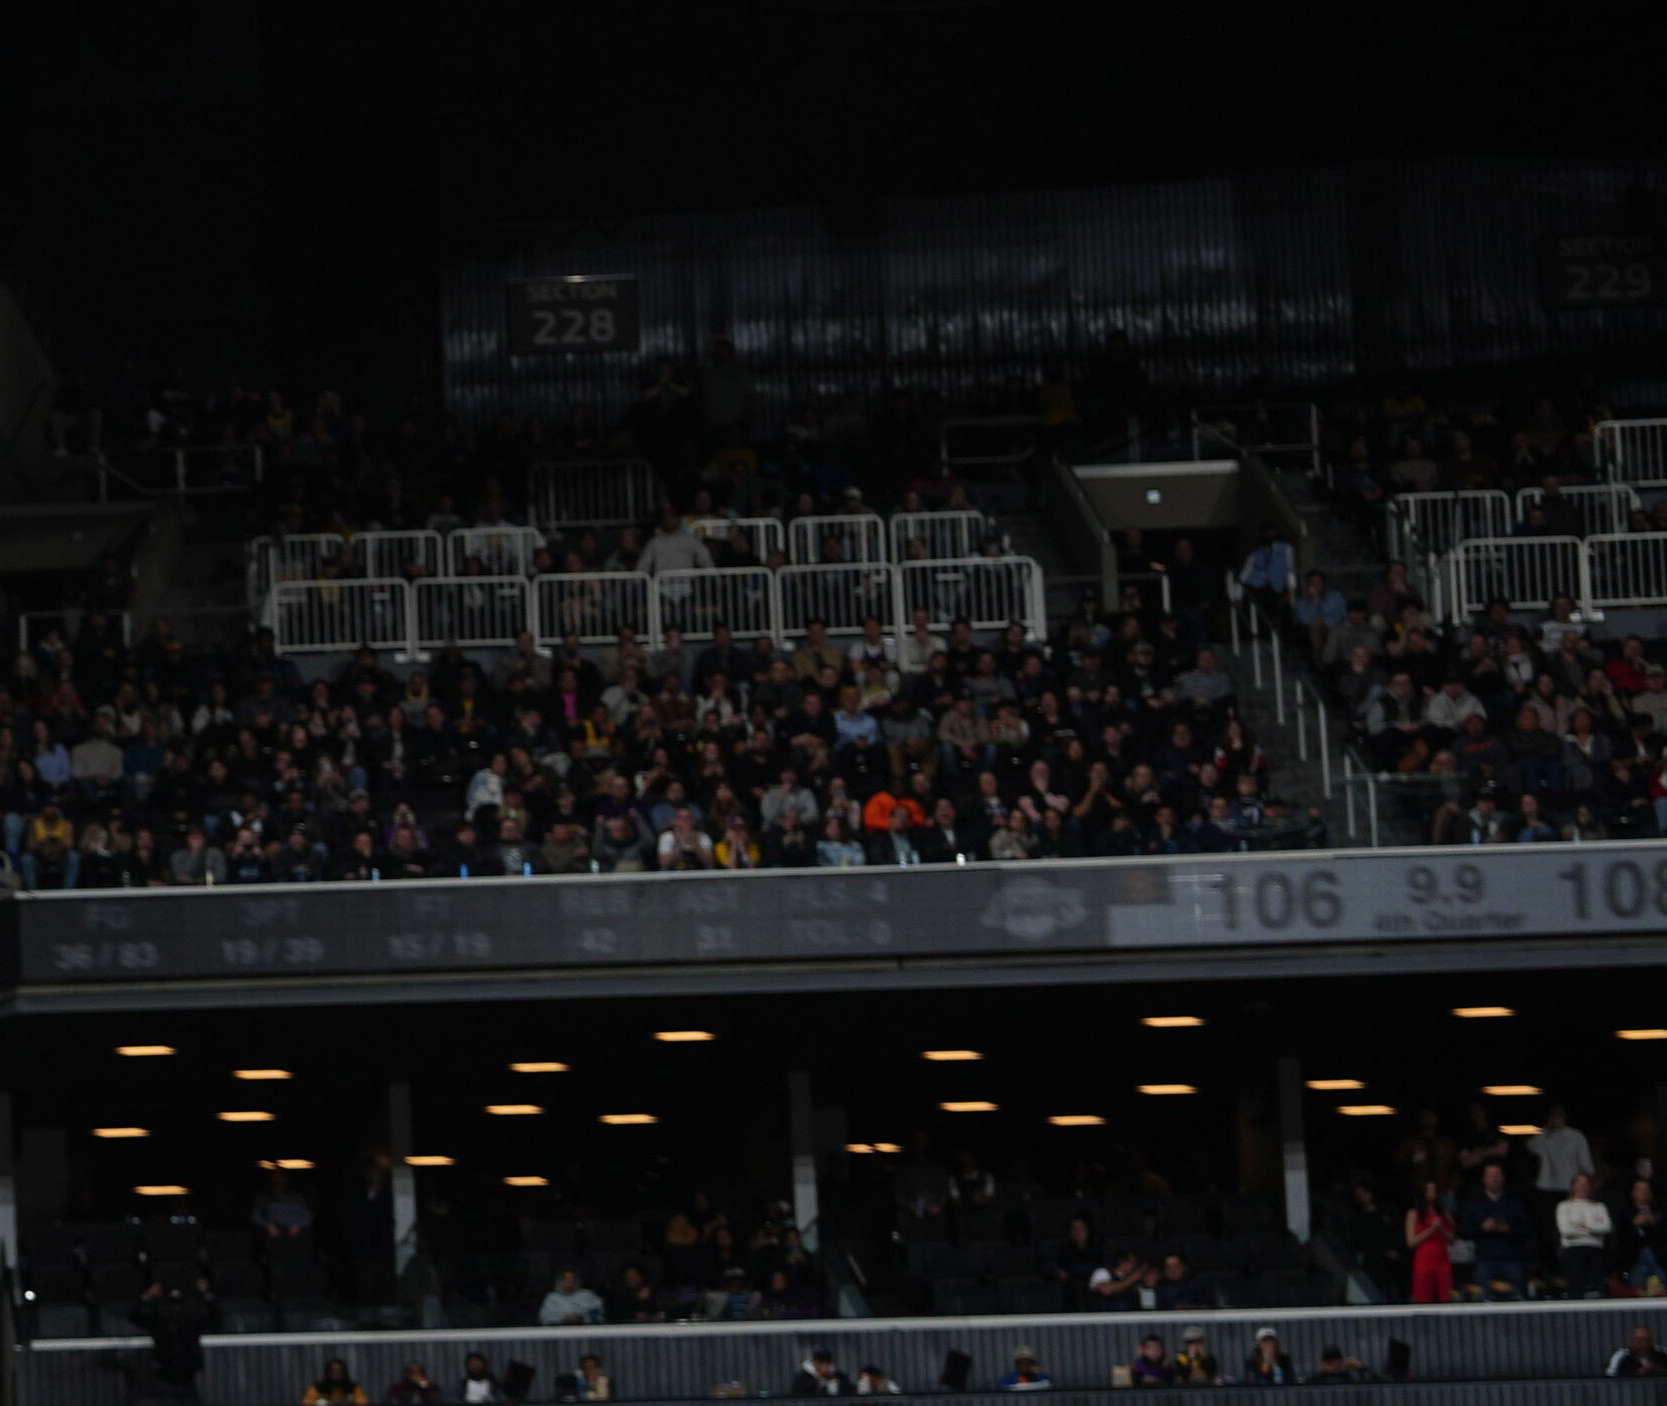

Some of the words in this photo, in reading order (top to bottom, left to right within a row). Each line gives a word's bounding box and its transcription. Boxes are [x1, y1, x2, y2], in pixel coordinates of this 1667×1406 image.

[1566, 263, 1652, 300] 229
[532, 309, 616, 345] 228
[1217, 872, 1344, 930] 106
